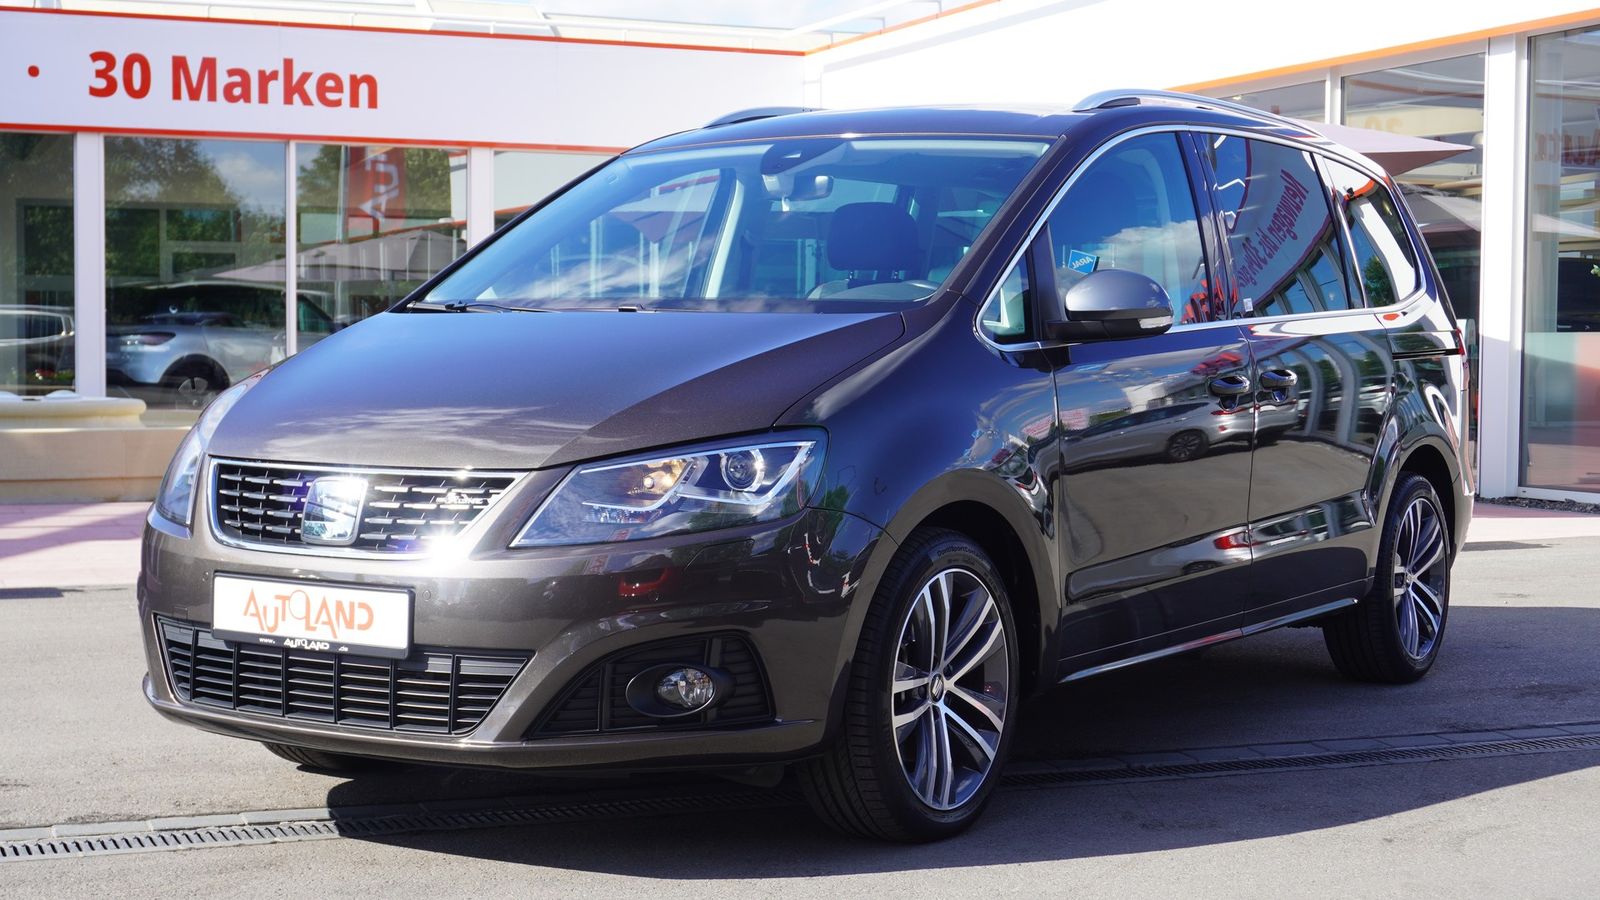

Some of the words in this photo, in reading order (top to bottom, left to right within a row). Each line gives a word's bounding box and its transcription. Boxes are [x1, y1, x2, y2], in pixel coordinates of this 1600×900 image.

[89, 51, 151, 99] 30
[171, 55, 379, 109] Marken
[243, 588, 374, 639] AUTOLAND
[284, 638, 329, 650] AUTOLAND
